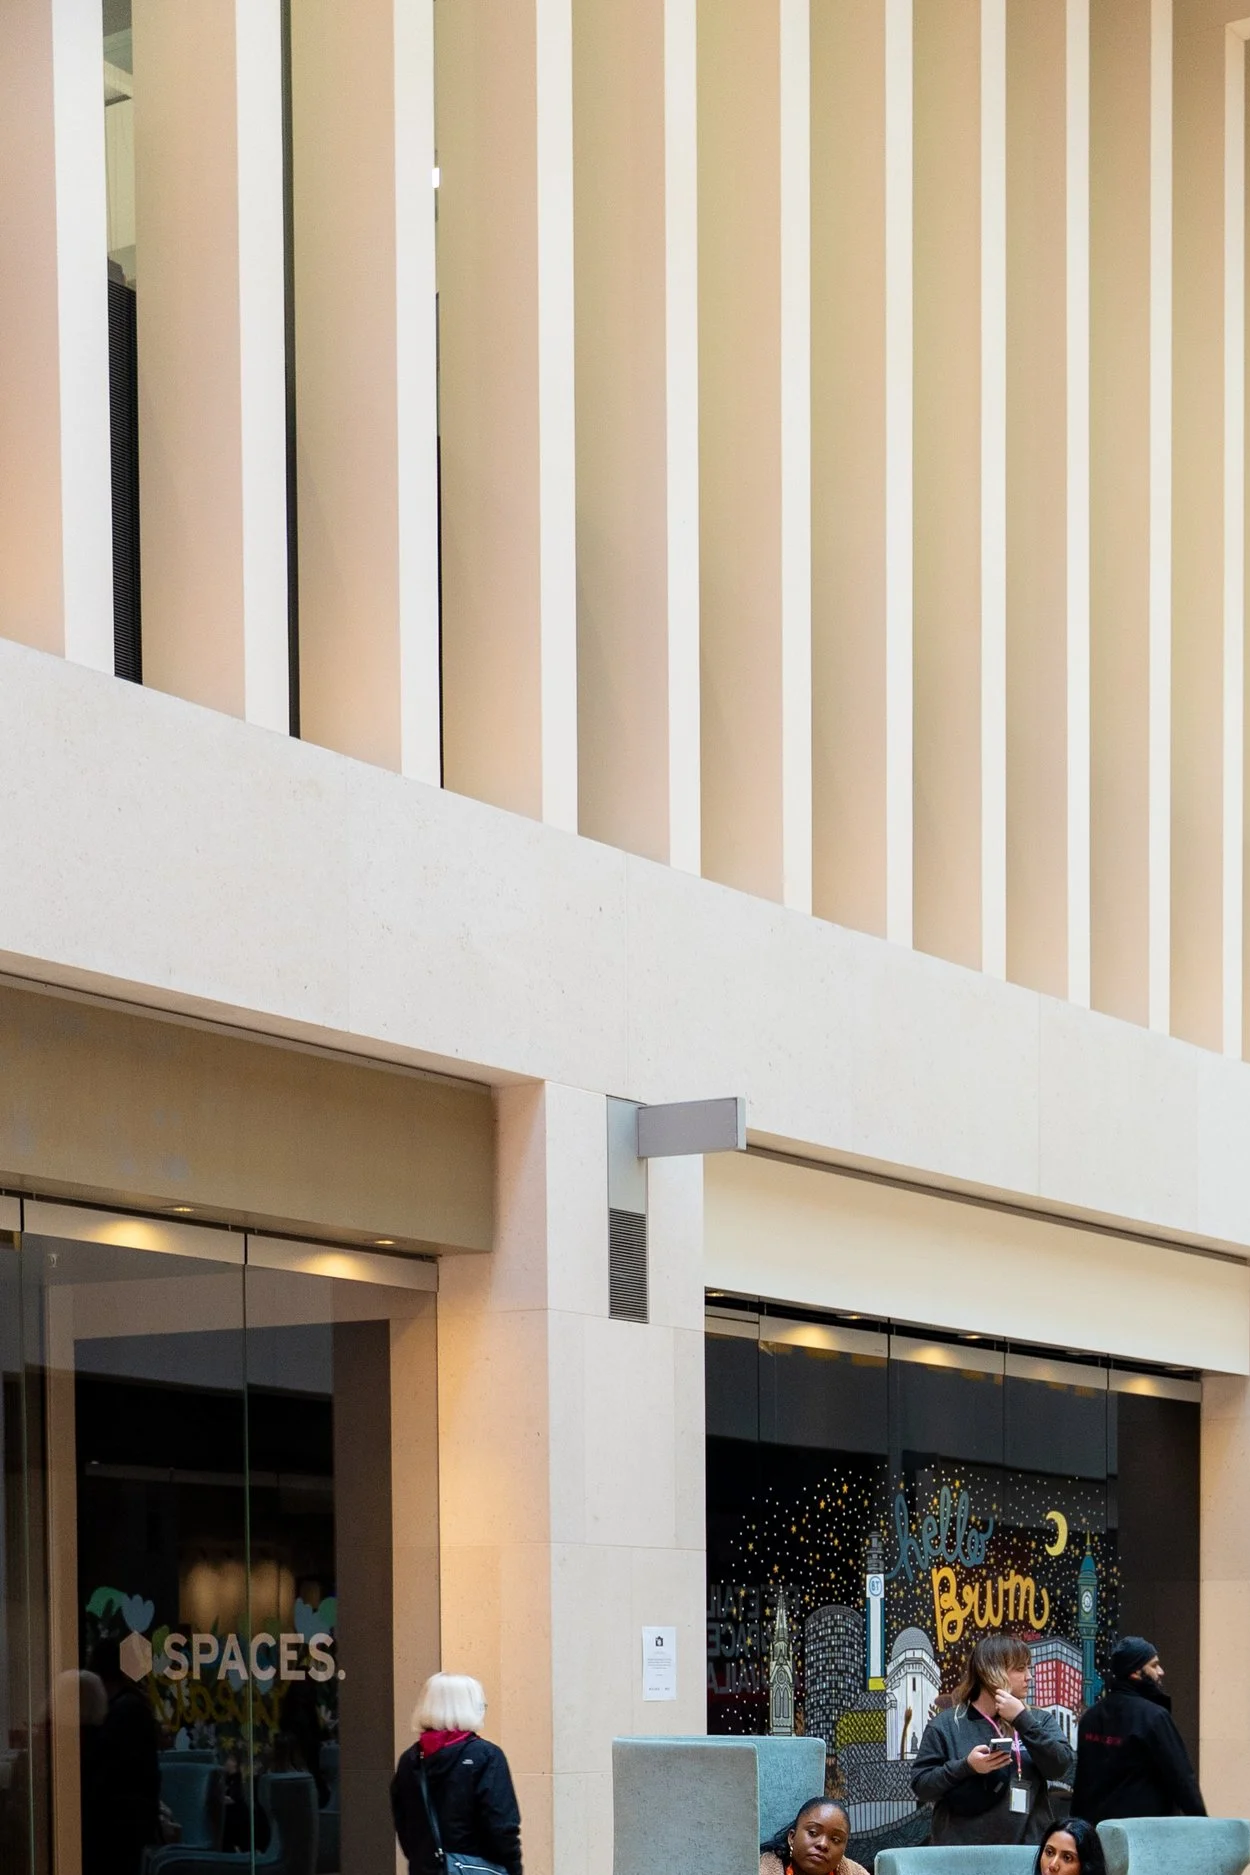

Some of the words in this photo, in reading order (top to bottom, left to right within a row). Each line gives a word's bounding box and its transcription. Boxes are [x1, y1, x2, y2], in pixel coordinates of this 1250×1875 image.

[884, 1485, 994, 1582] hello
[931, 1566, 1050, 1652] Brum
[162, 1631, 347, 1683] SPACES.
